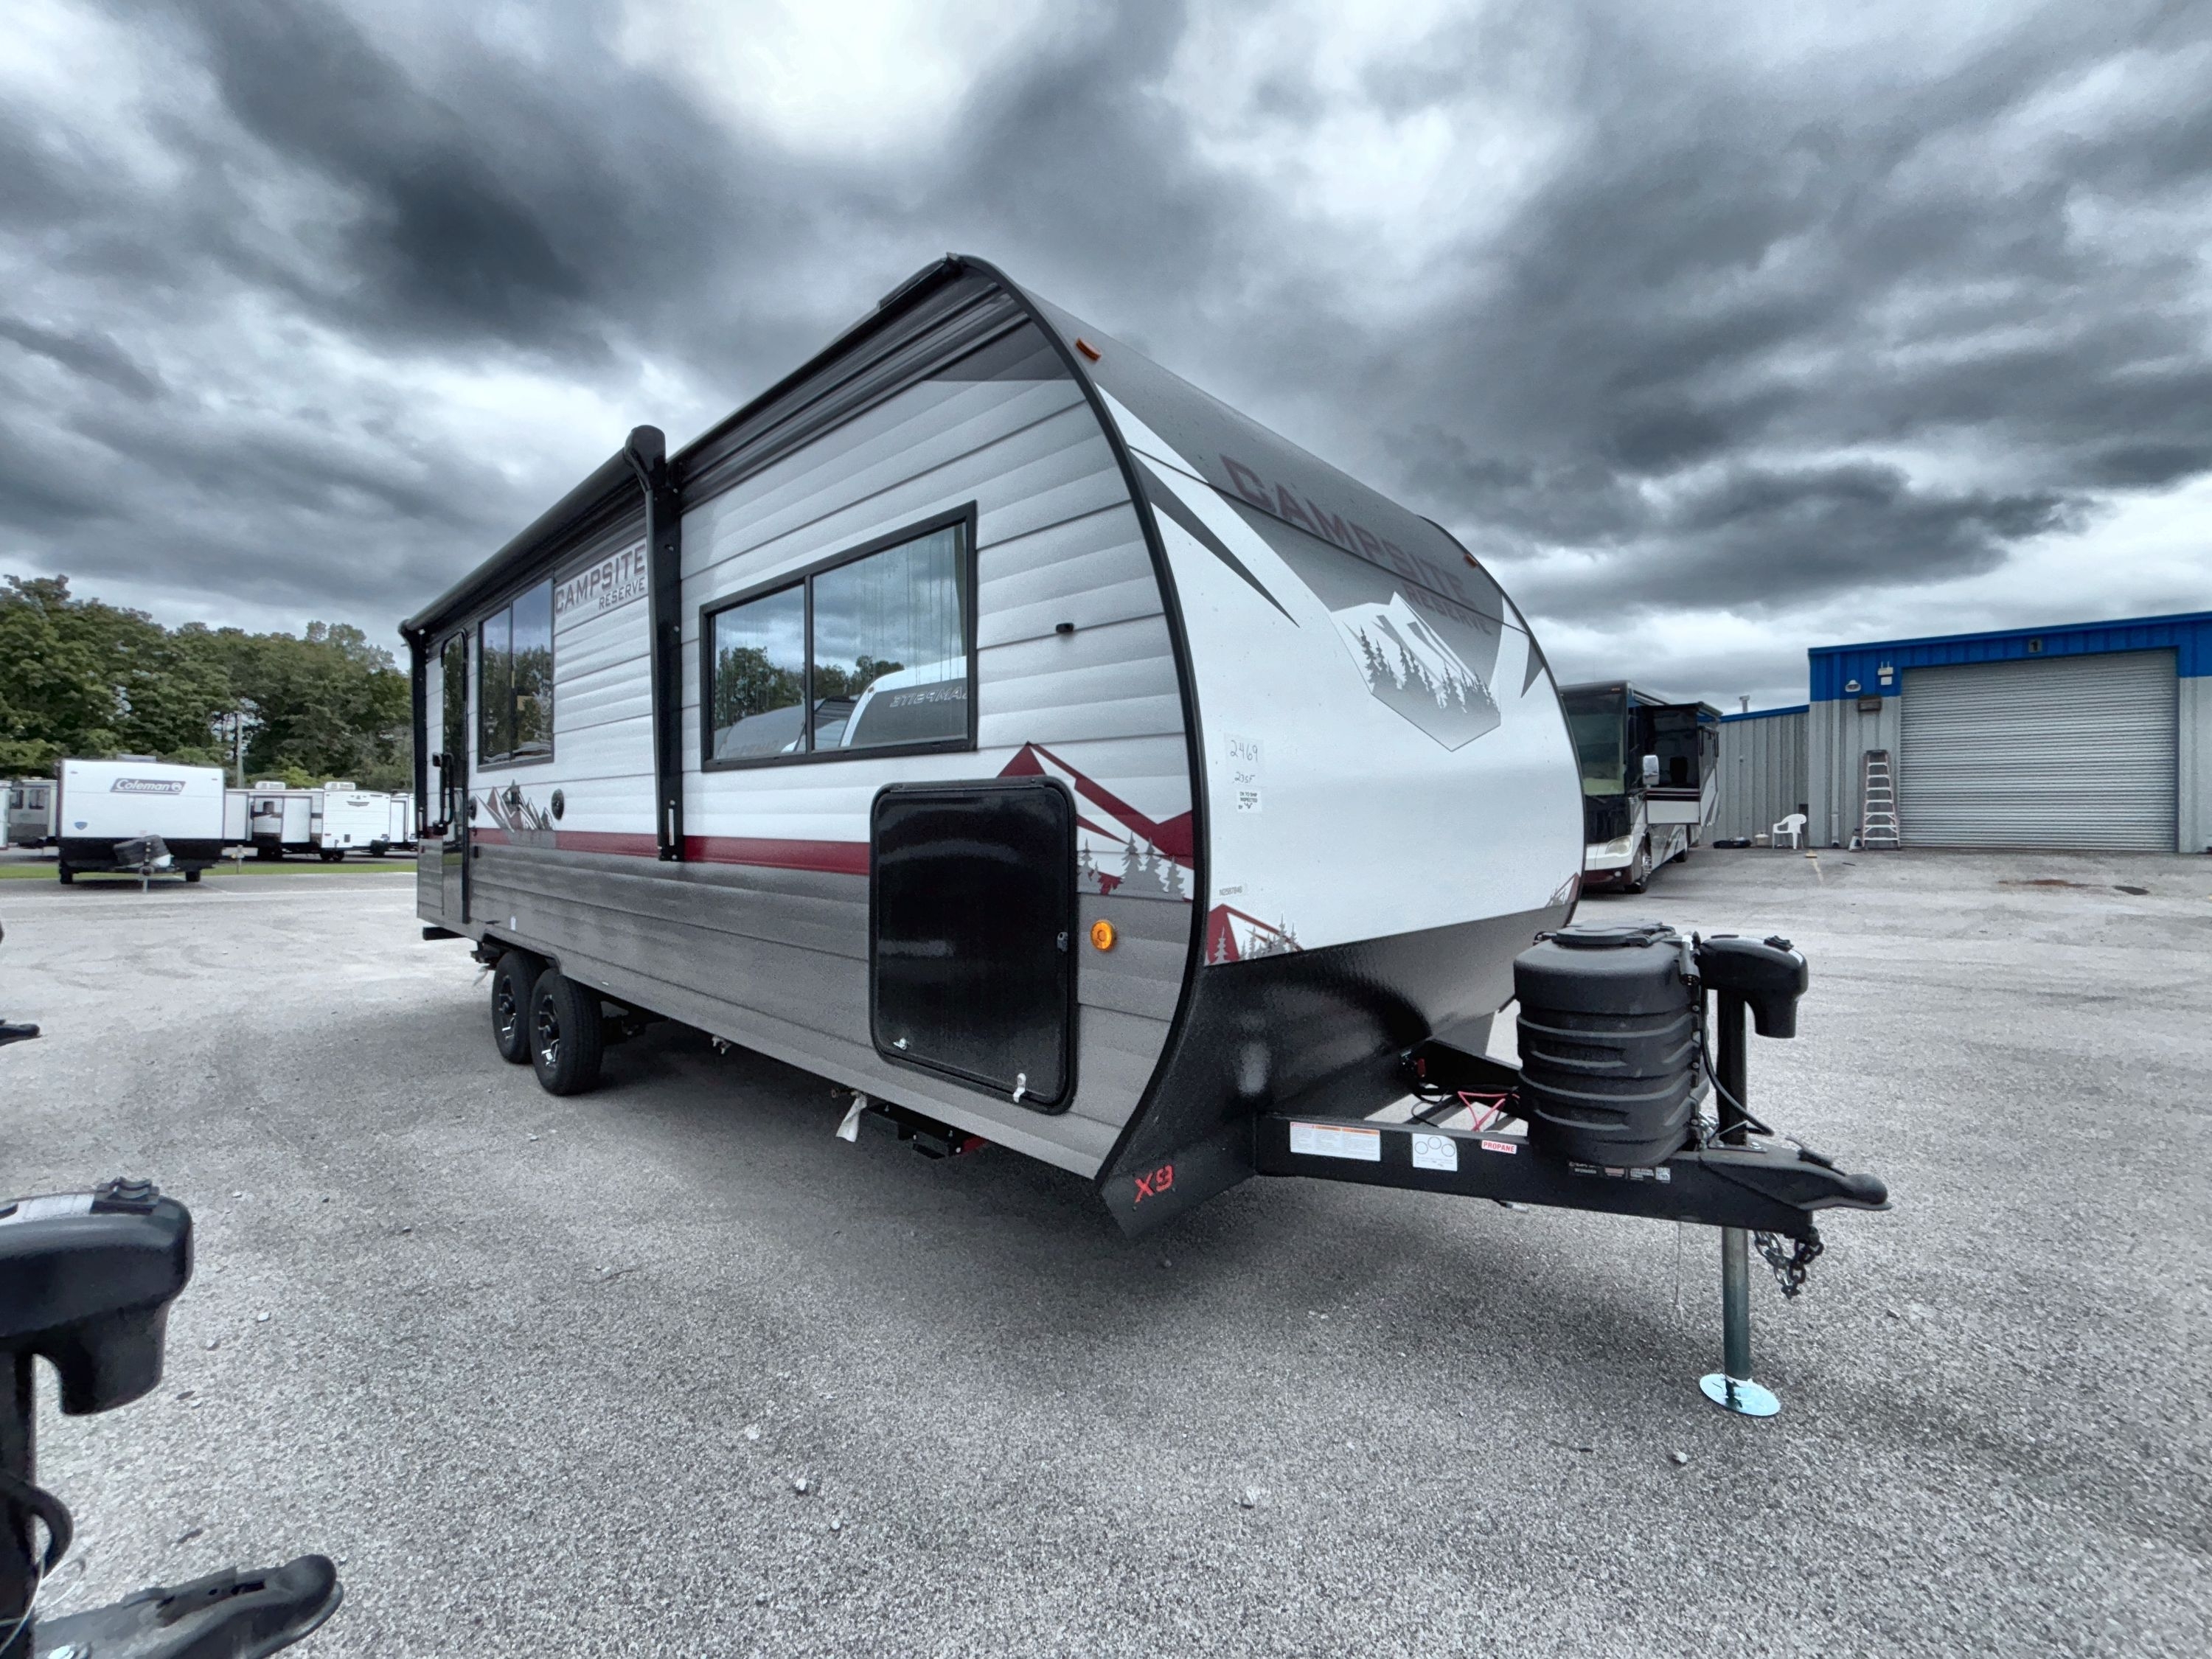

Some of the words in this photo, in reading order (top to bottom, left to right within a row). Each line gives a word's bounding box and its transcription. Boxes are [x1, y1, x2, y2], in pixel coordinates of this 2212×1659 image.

[1218, 453, 1478, 611] CAMPSITE
[555, 543, 646, 613] CAMPSITE
[599, 577, 645, 611] RESERVE
[1401, 578, 1492, 636] RESERVE
[1230, 740, 1258, 762] 2469
[116, 779, 171, 791] Coleman
[1483, 1141, 1515, 1152] PROPANE
